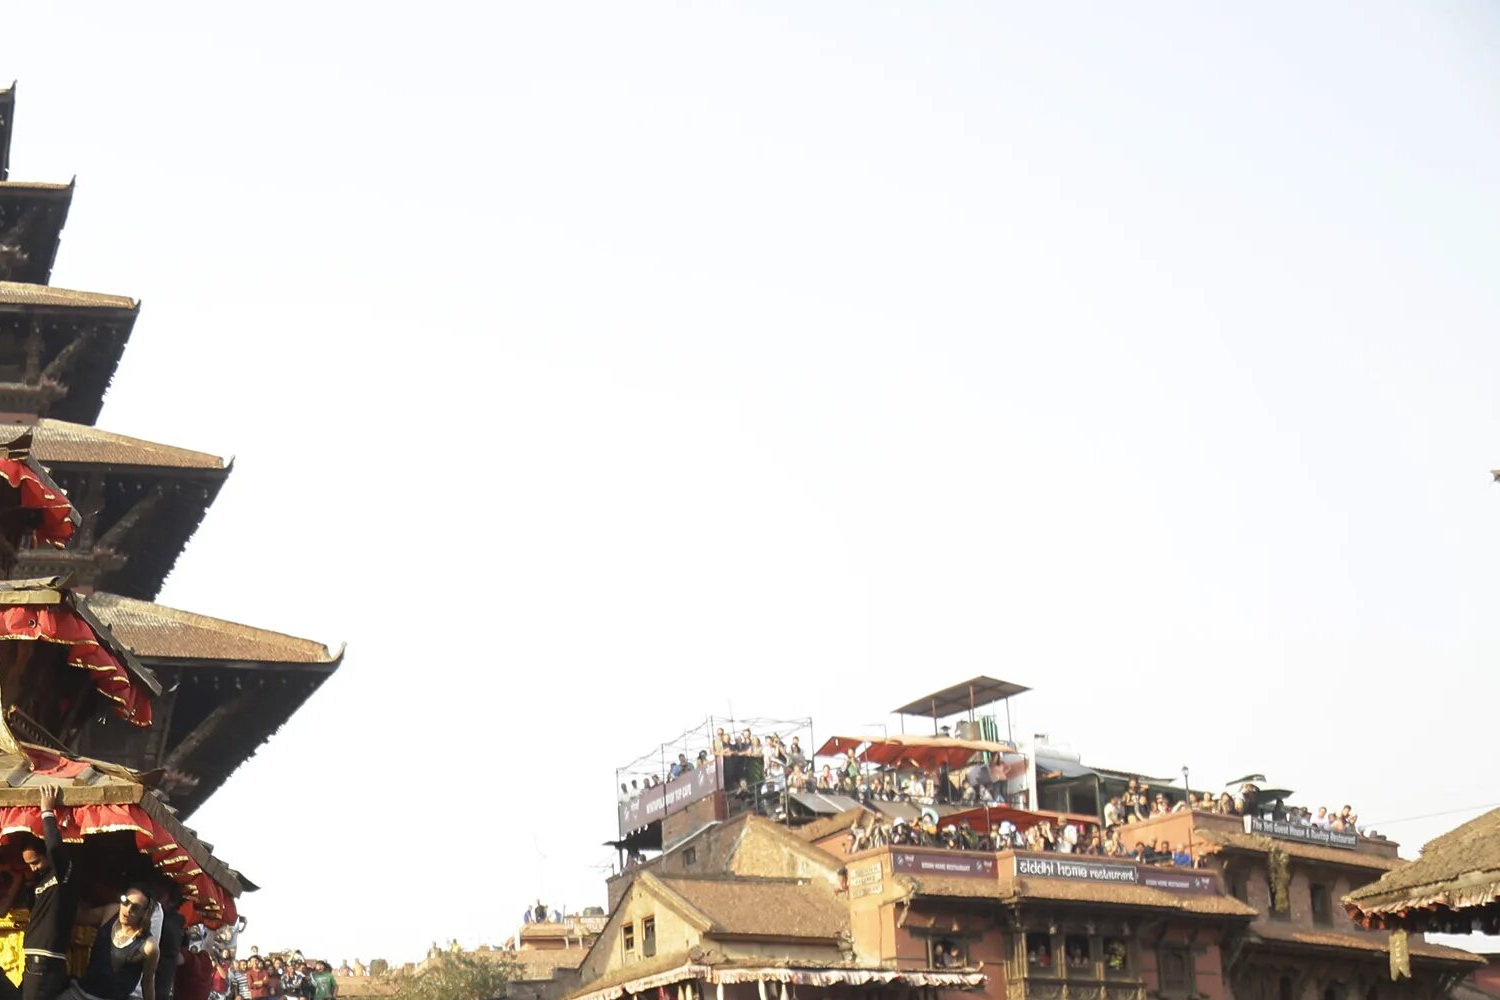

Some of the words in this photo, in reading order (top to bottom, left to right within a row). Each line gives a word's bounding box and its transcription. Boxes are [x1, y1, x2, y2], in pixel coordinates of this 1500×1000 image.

[1252, 819, 1263, 832] The
[1274, 822, 1289, 835] Guest
[1289, 825, 1305, 838] House
[1330, 831, 1356, 845] Restaurant
[946, 863, 971, 872] RESTAURANT
[1020, 859, 1054, 876] siddhi
[1057, 861, 1088, 878] home
[1089, 869, 1134, 882] restaurant
